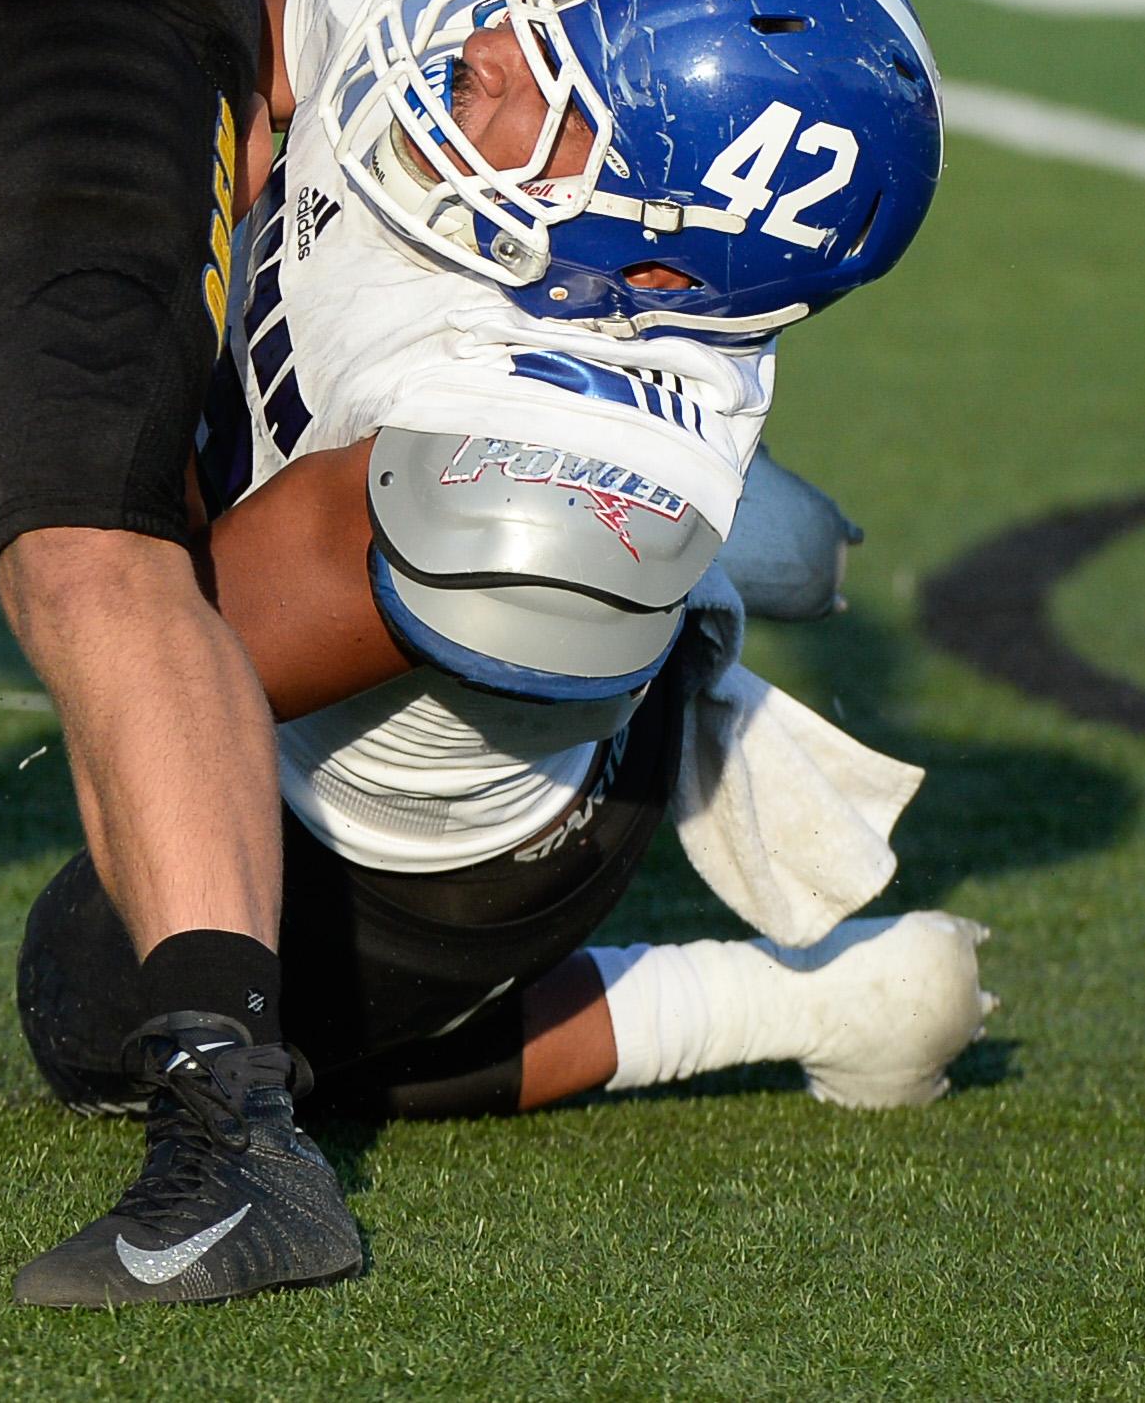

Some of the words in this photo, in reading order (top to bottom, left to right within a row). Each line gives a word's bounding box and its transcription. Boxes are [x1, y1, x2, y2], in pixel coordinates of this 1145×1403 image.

[606, 148, 628, 176] PEED
[701, 100, 859, 251] 42
[296, 186, 314, 262] adidas
[440, 435, 690, 522] POWER
